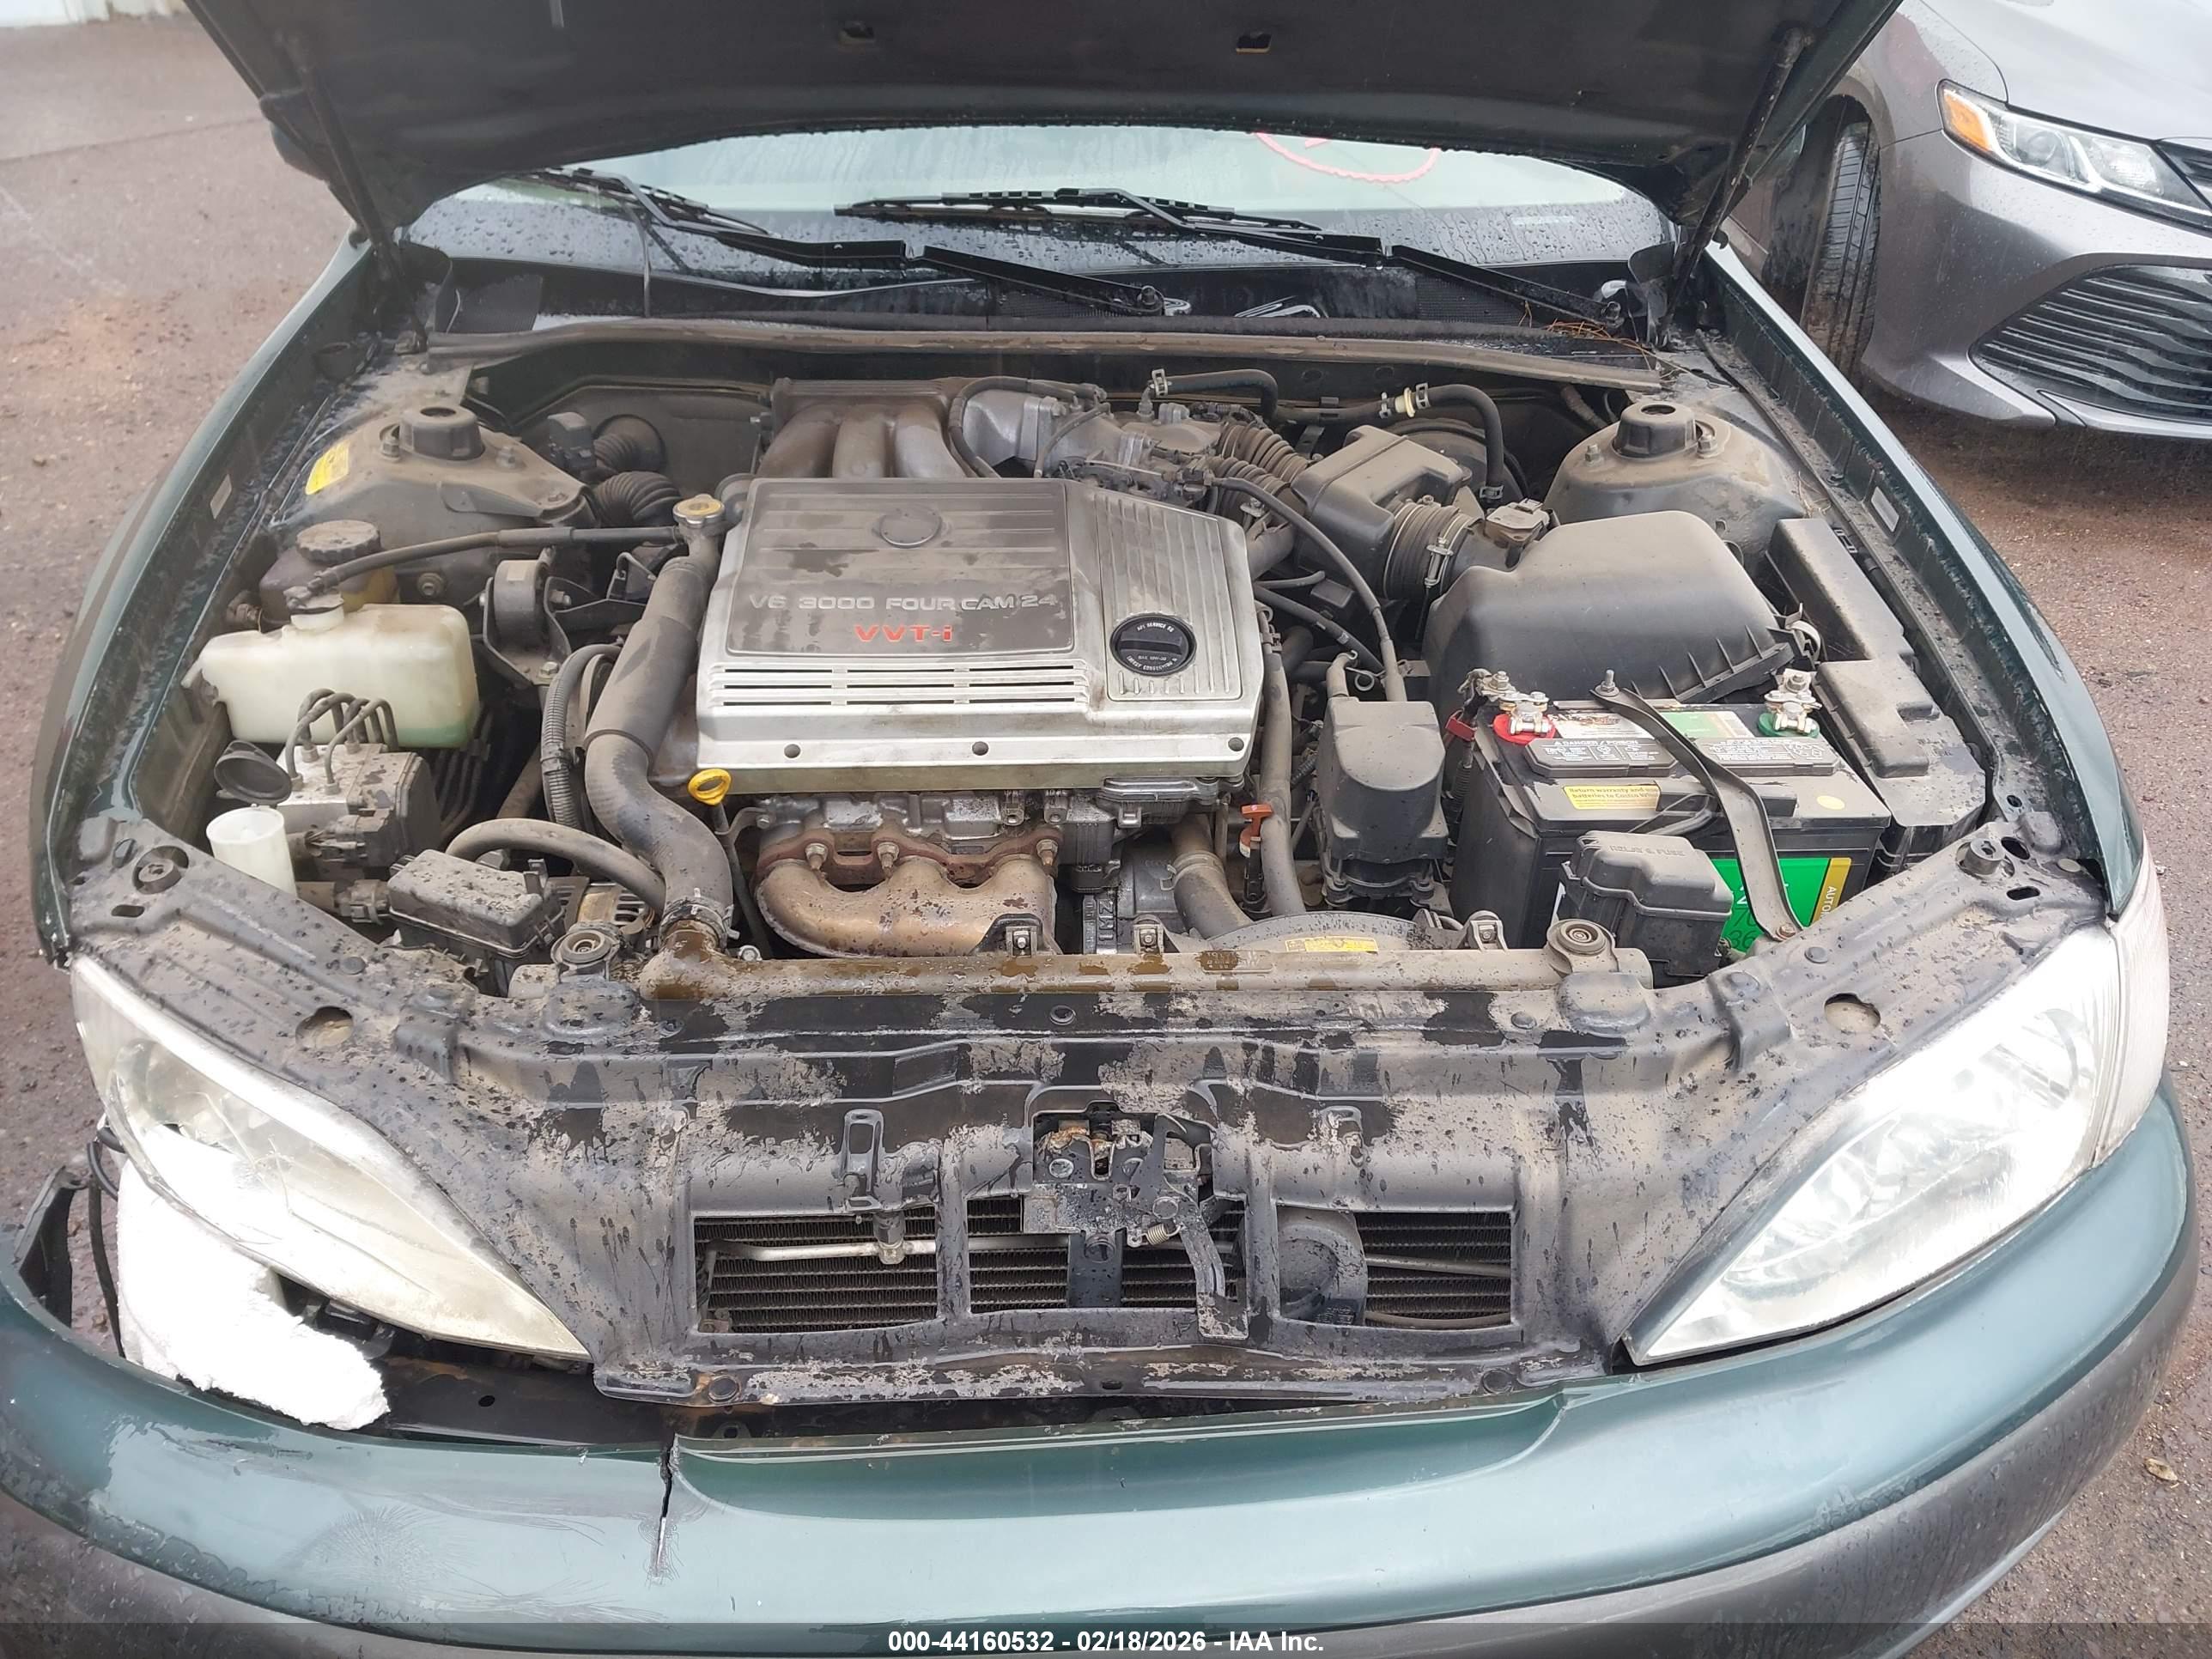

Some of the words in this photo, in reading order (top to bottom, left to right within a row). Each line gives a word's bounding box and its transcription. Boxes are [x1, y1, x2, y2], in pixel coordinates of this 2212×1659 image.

[749, 594, 787, 609] V6
[799, 596, 875, 610] 3000
[885, 597, 956, 611] FOUR
[961, 595, 1015, 611] CAM
[1021, 594, 1059, 607] 24
[854, 624, 954, 643] VVT-i
